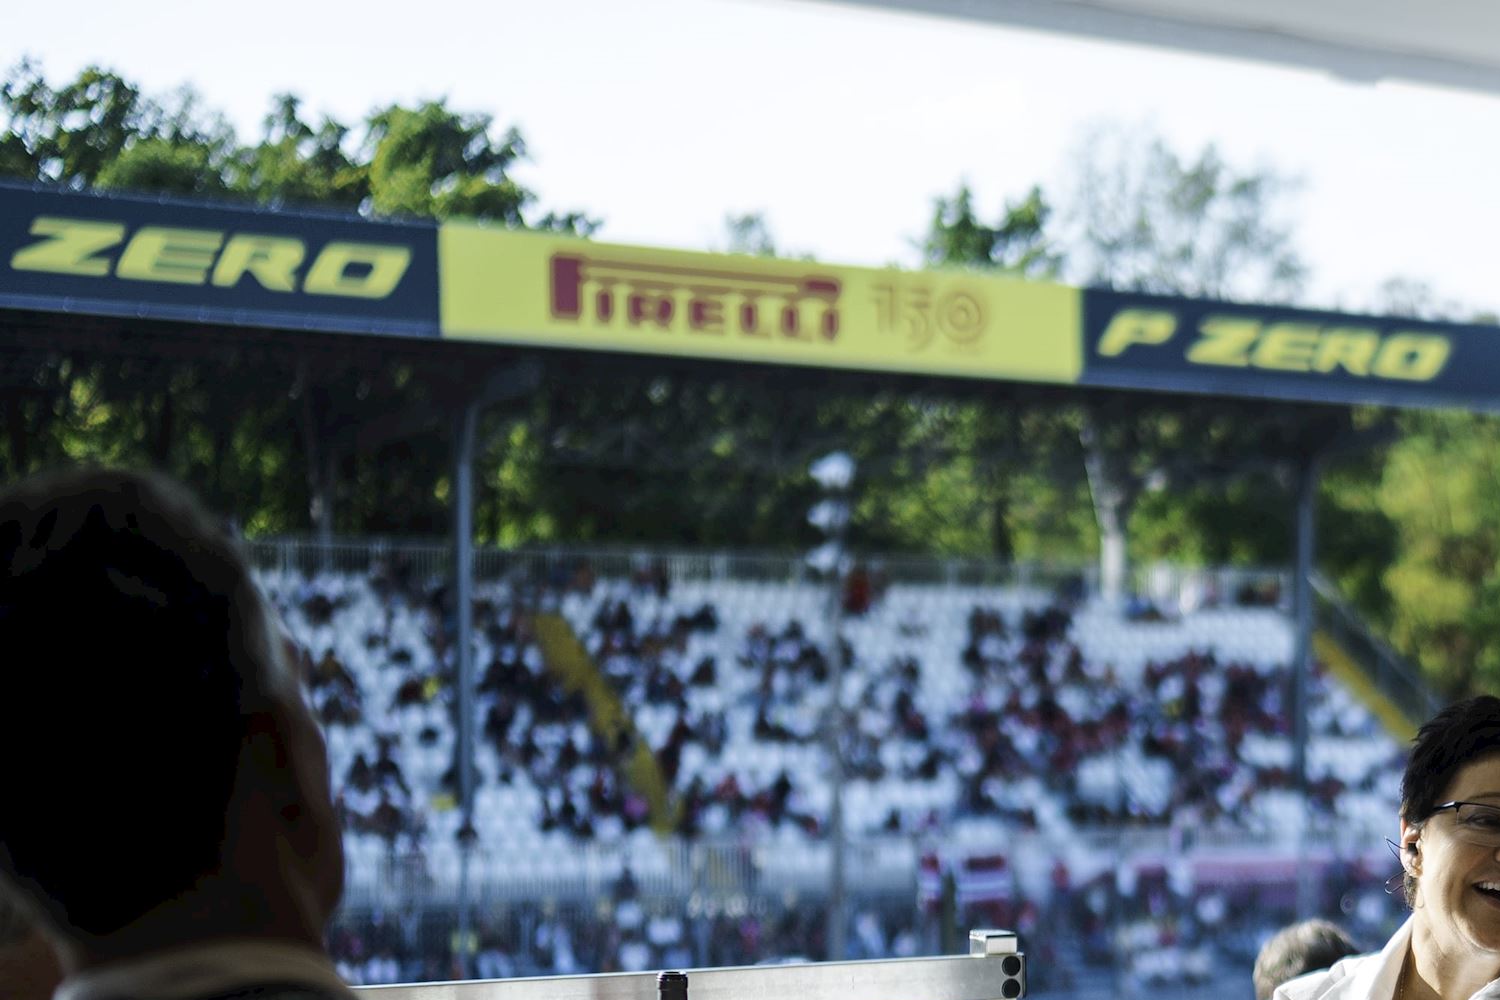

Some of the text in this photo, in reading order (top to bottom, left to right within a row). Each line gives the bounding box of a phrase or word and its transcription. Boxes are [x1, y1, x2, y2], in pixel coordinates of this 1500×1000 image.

[10, 214, 411, 300] ZERO
[549, 250, 842, 343] PIRELLI
[1097, 306, 1455, 382] P ZERO
